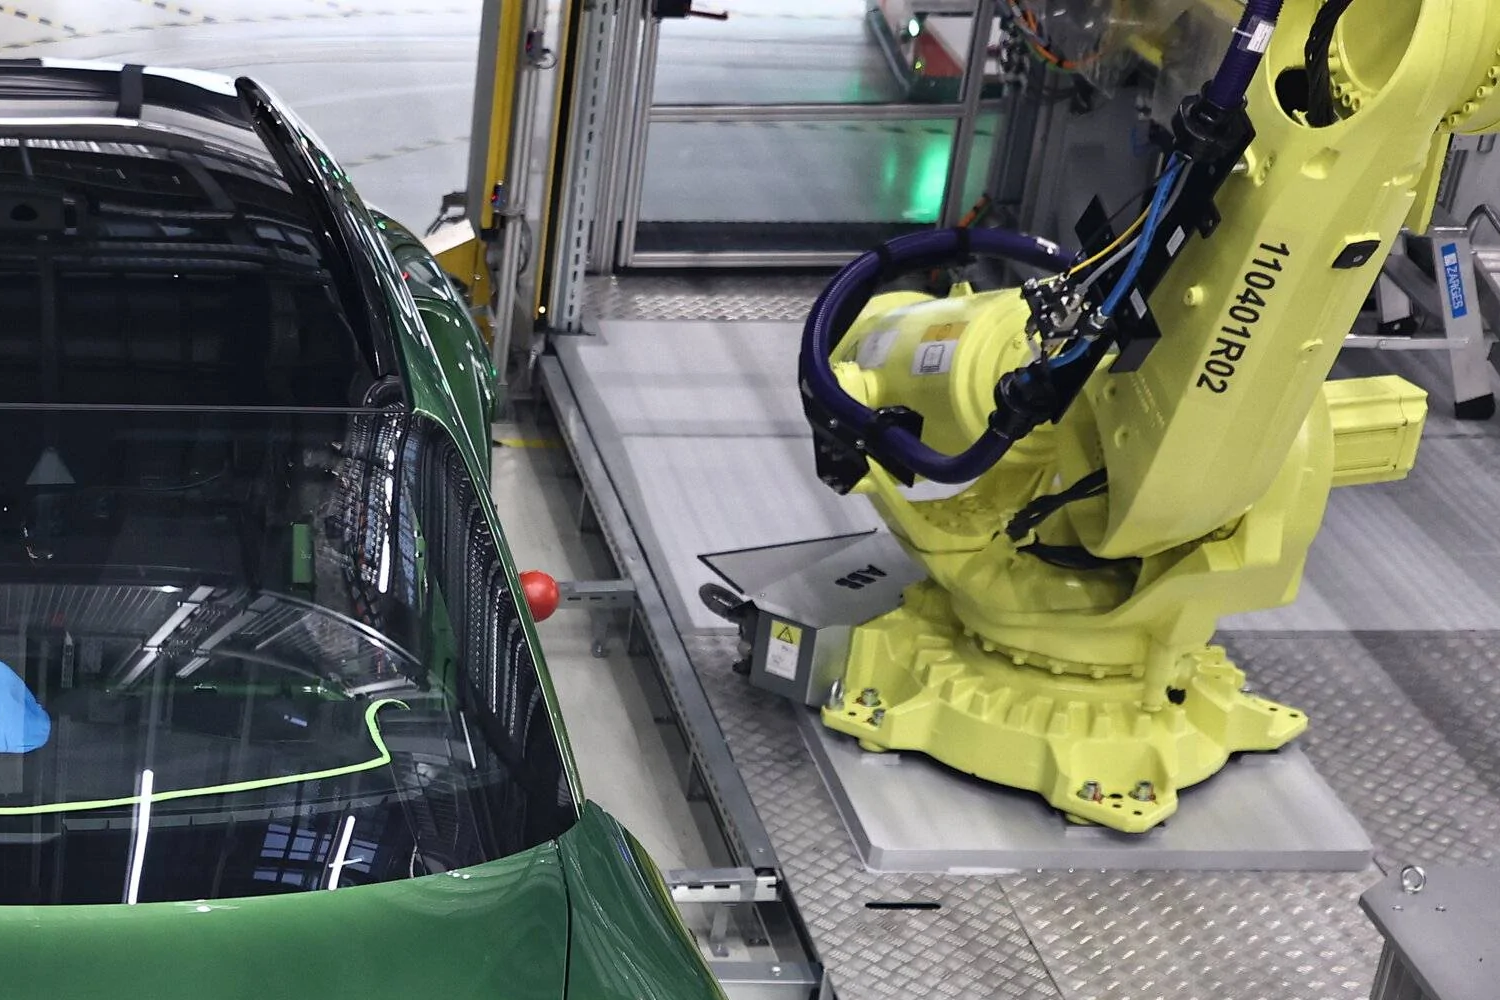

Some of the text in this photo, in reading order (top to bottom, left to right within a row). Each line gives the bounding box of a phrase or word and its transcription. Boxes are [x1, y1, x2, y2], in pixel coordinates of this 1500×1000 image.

[1446, 265, 1464, 309] ZARGES
[1196, 242, 1291, 394] 110401R02
[834, 563, 888, 590] ABB
